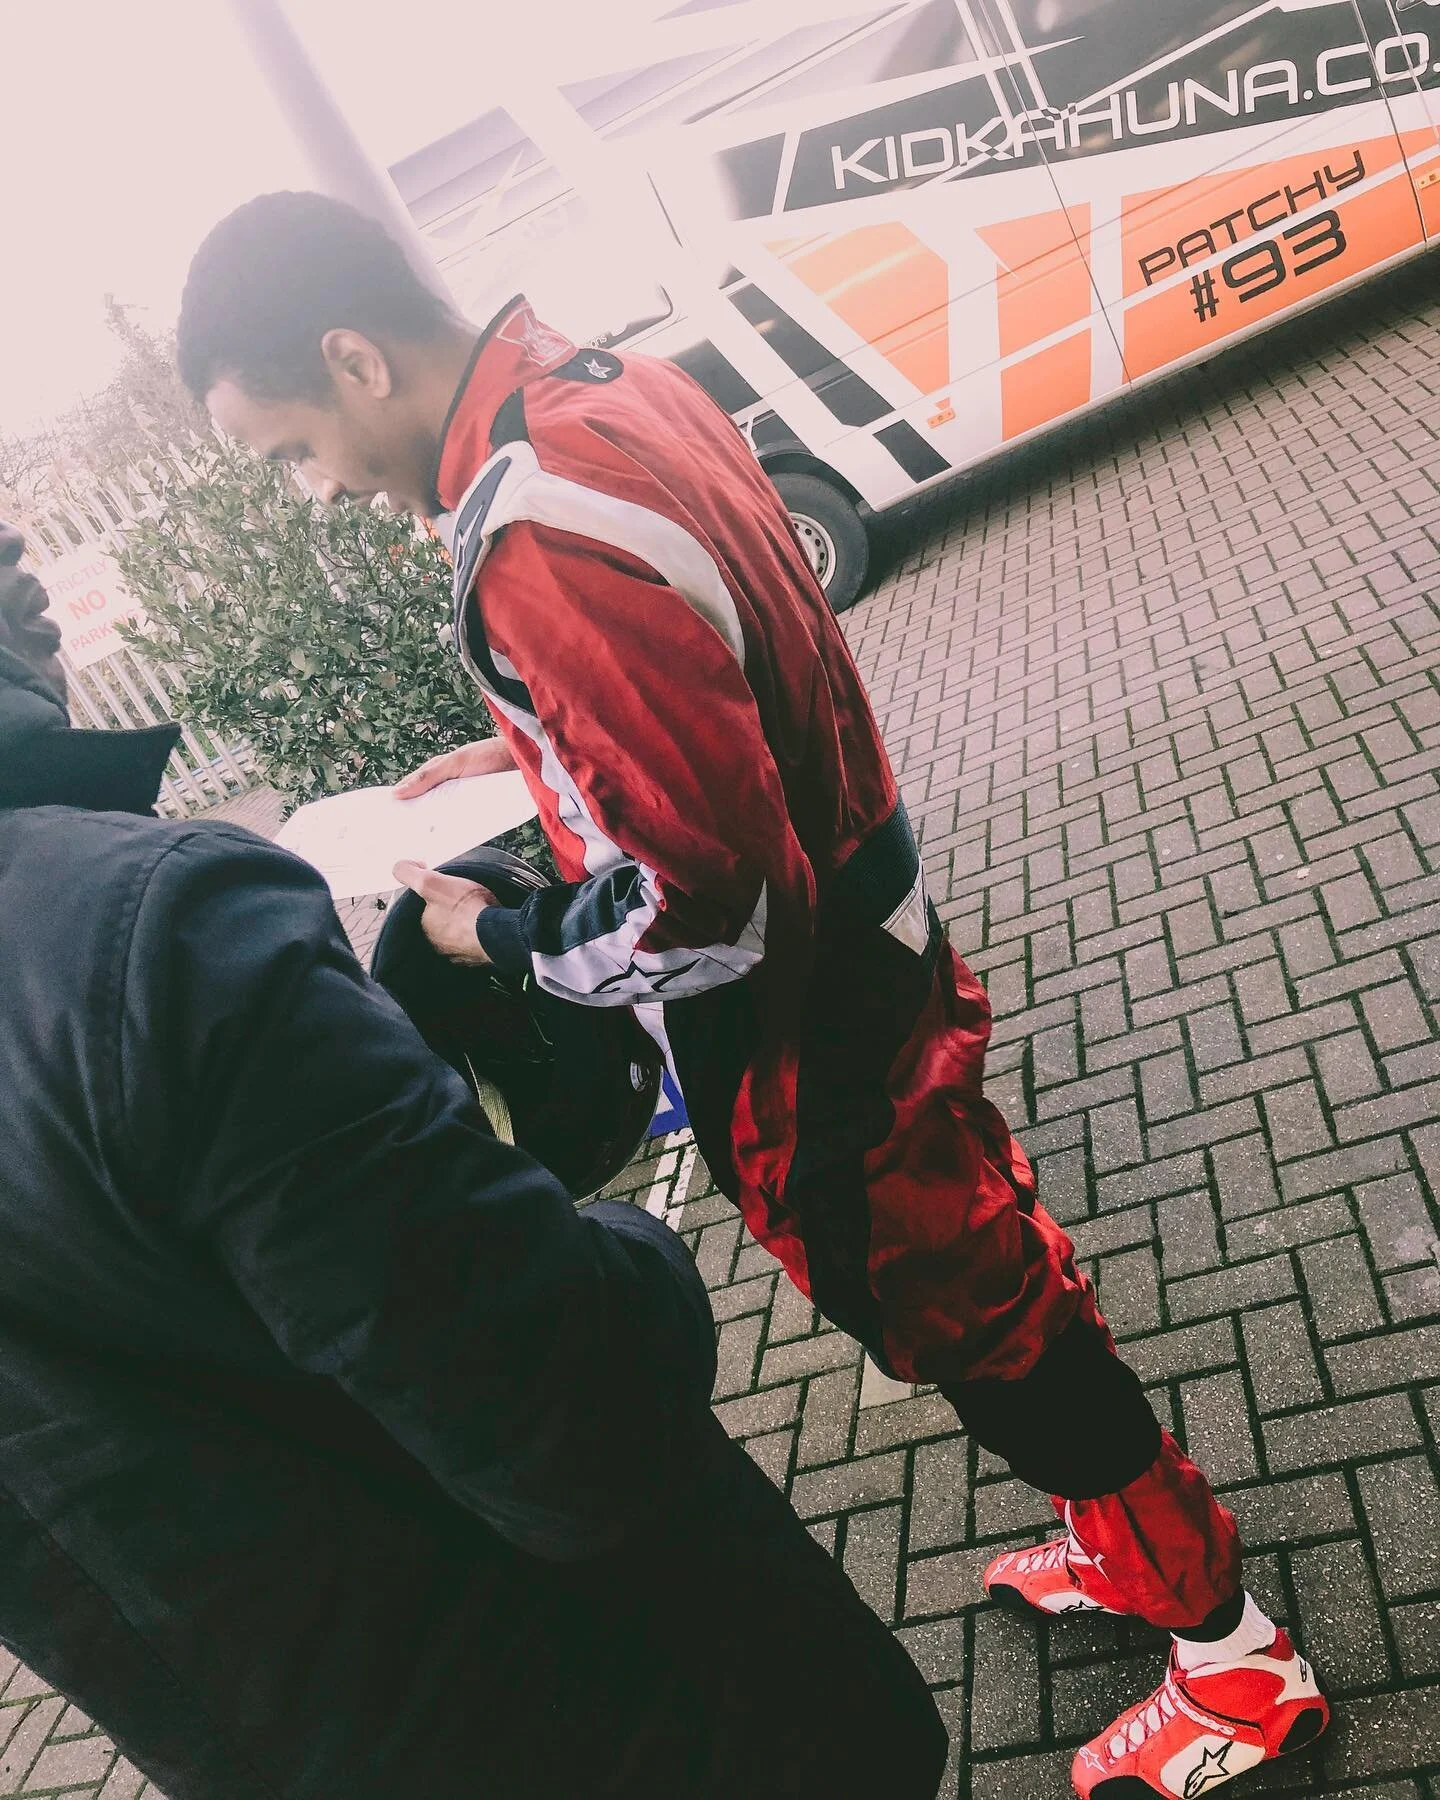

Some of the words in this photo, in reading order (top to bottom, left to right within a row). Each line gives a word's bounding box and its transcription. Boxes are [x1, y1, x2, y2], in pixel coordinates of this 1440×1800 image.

[1138, 149, 1366, 286] PATCHY
[1189, 209, 1347, 322] #93
[47, 557, 109, 598] TRICTLY
[68, 589, 106, 622] NO
